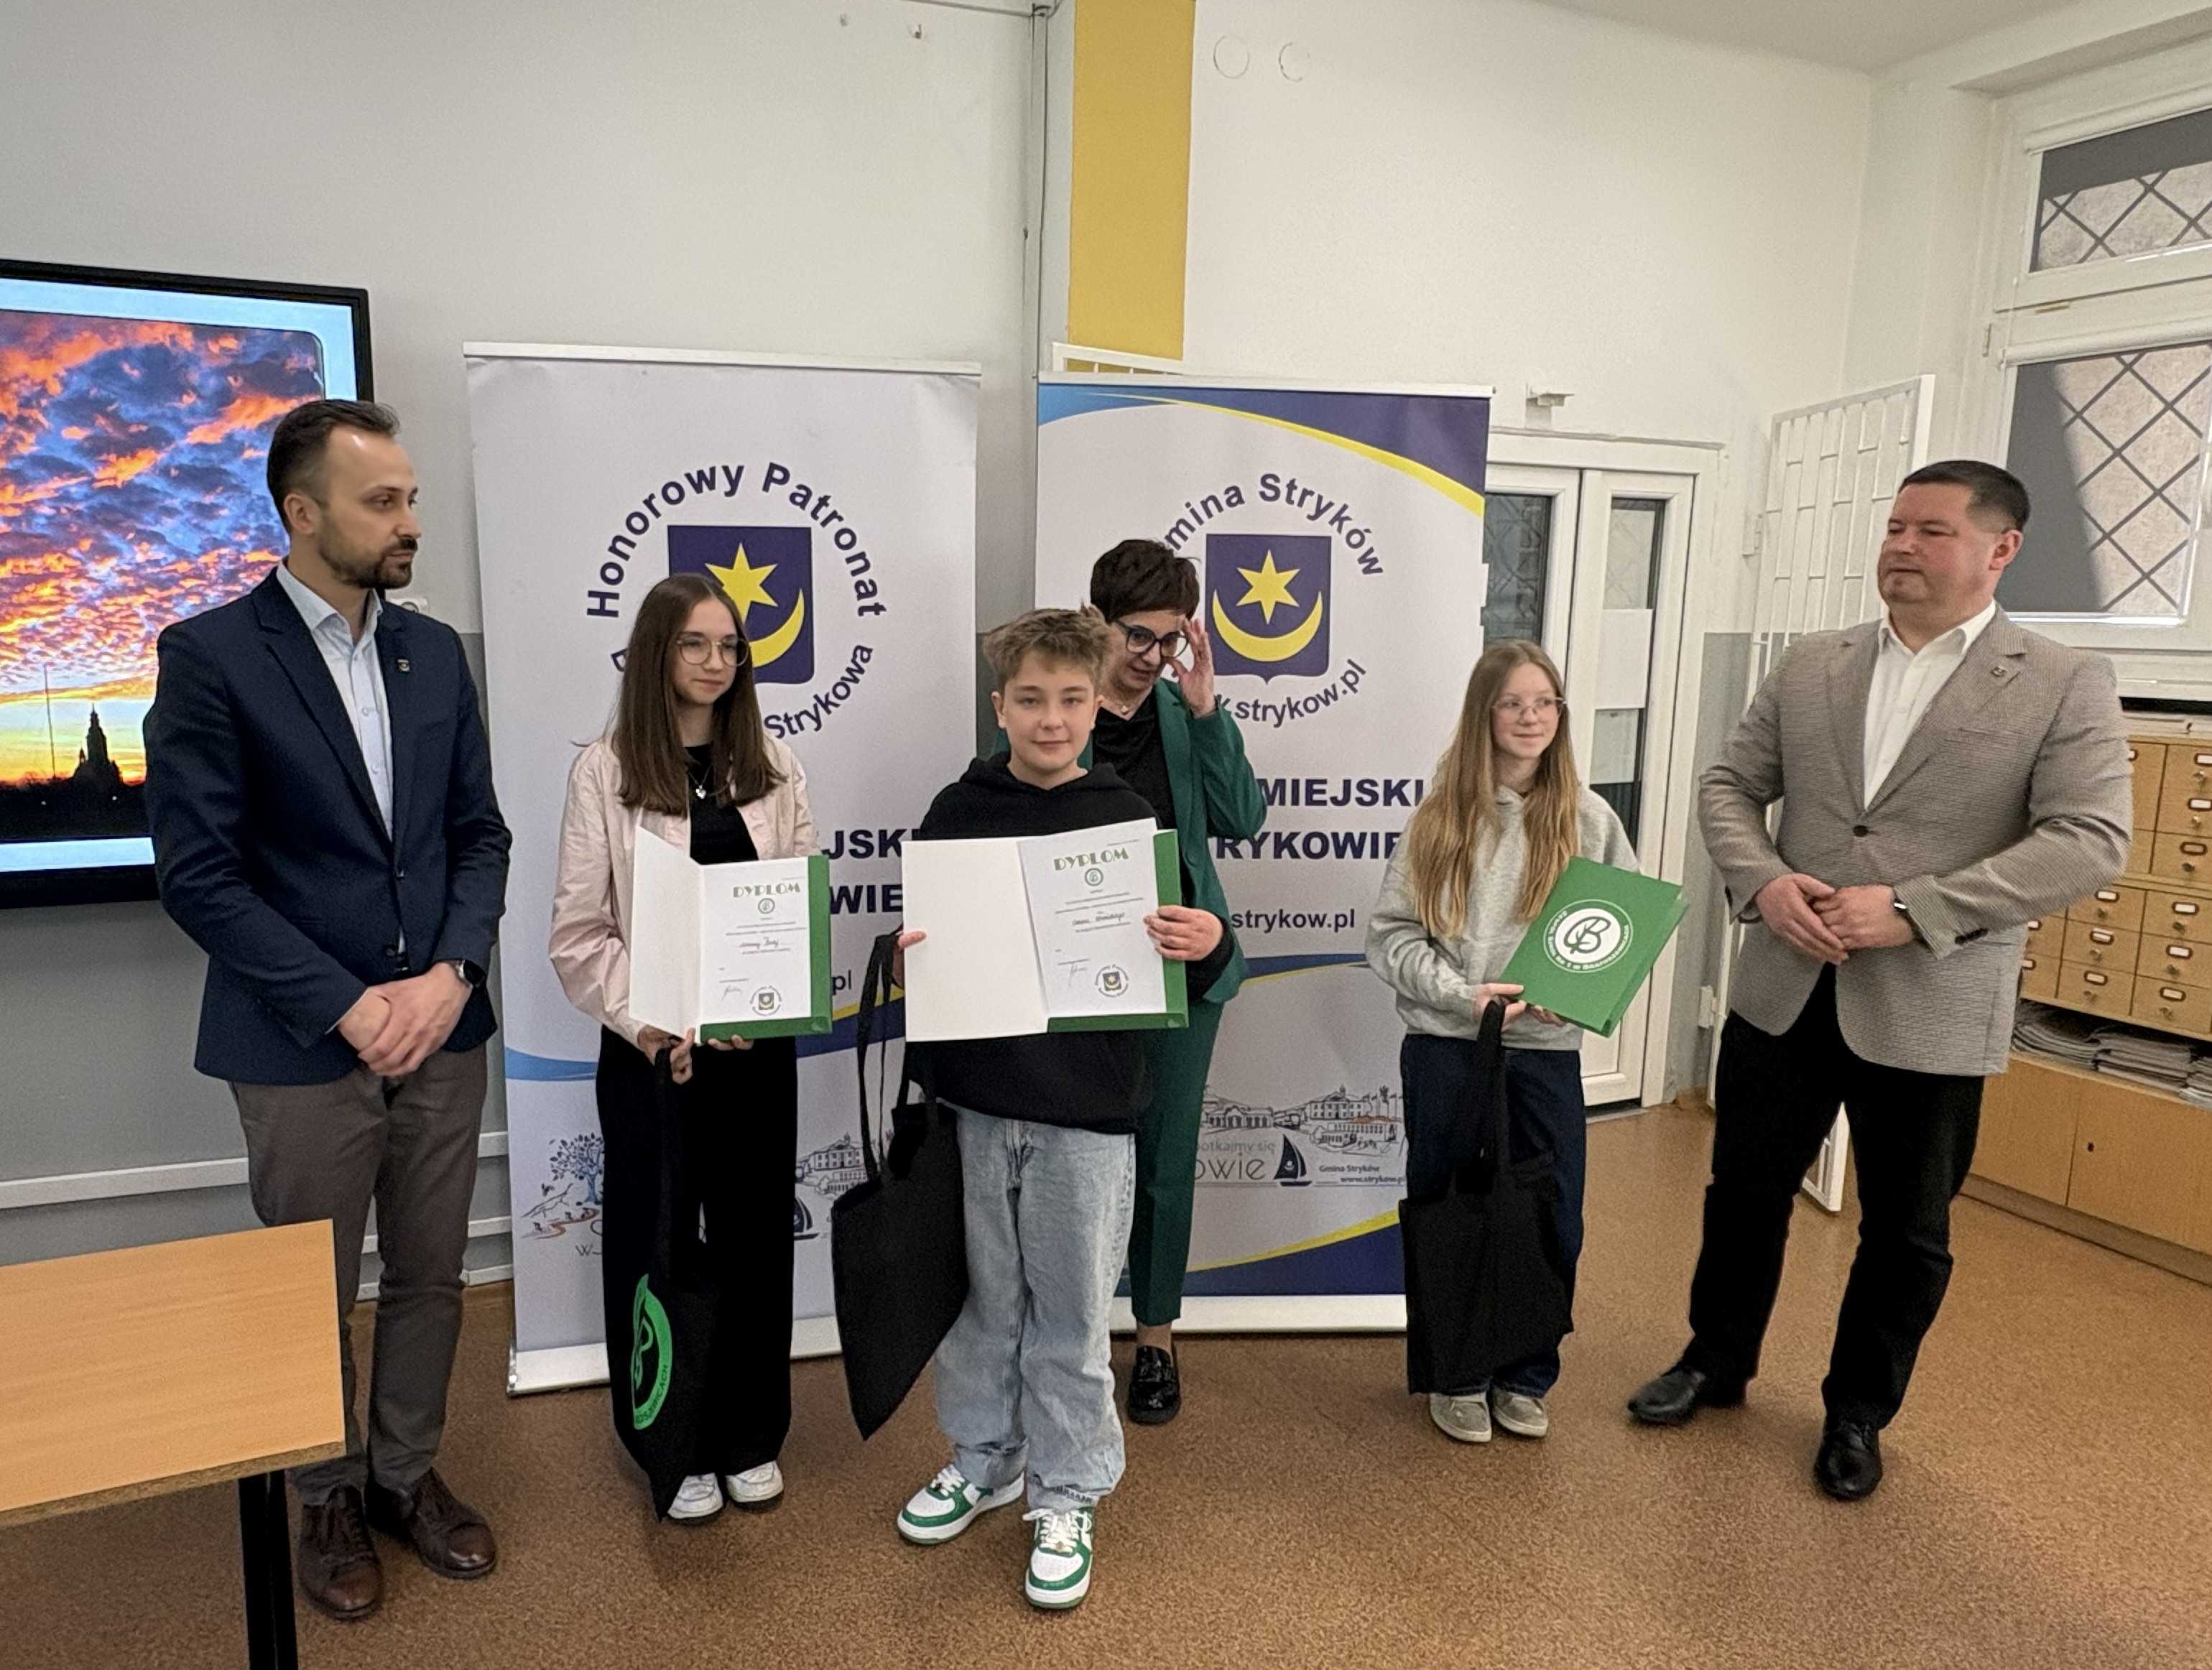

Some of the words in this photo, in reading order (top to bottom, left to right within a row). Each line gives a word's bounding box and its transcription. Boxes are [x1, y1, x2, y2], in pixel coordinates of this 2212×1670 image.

[1164, 485, 1245, 550] mina
[1259, 473, 1384, 575] Stryków
[586, 465, 744, 618] Honorowy
[762, 462, 887, 617] Patronat
[764, 644, 874, 739] Strykowa
[1217, 659, 1366, 728] strykow.pl
[1256, 778, 1424, 807] MIEJSKI
[1054, 847, 1129, 871] DYPLOM
[1216, 831, 1402, 859] RYKOWIE
[733, 882, 801, 898] DYPLOM
[1231, 909, 1355, 934] strykow.pl
